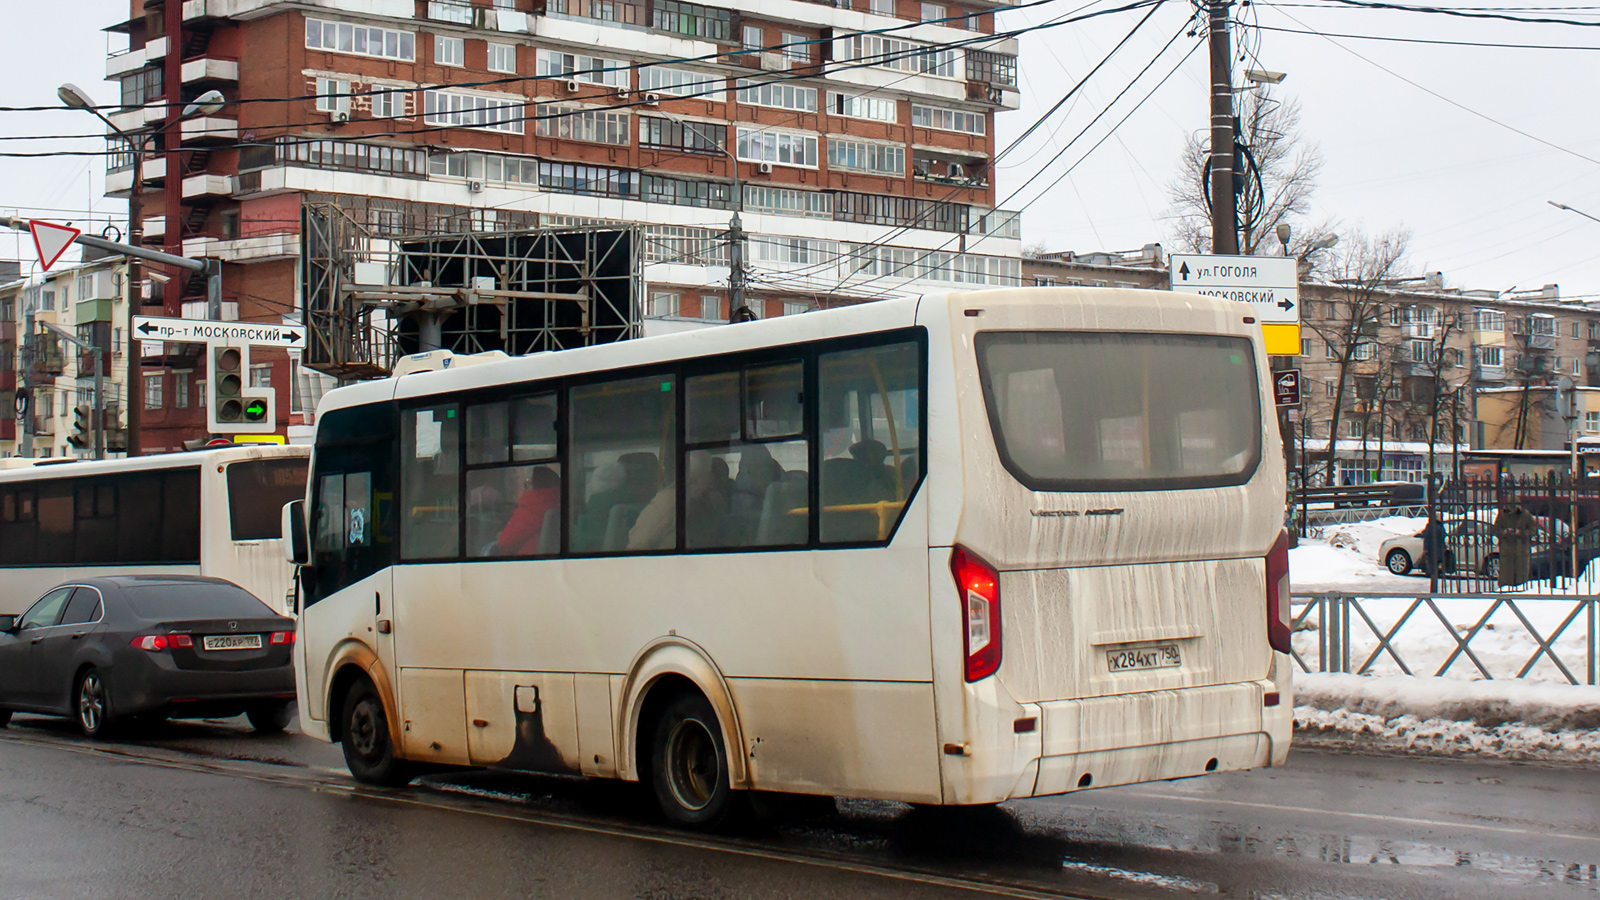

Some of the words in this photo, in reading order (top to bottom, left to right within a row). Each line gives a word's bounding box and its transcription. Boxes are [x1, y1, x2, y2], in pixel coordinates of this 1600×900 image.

[160, 325, 189, 338] пр-т
[193, 325, 280, 341] МОСКОВСКИЙ
[1160, 647, 1177, 660] 750
